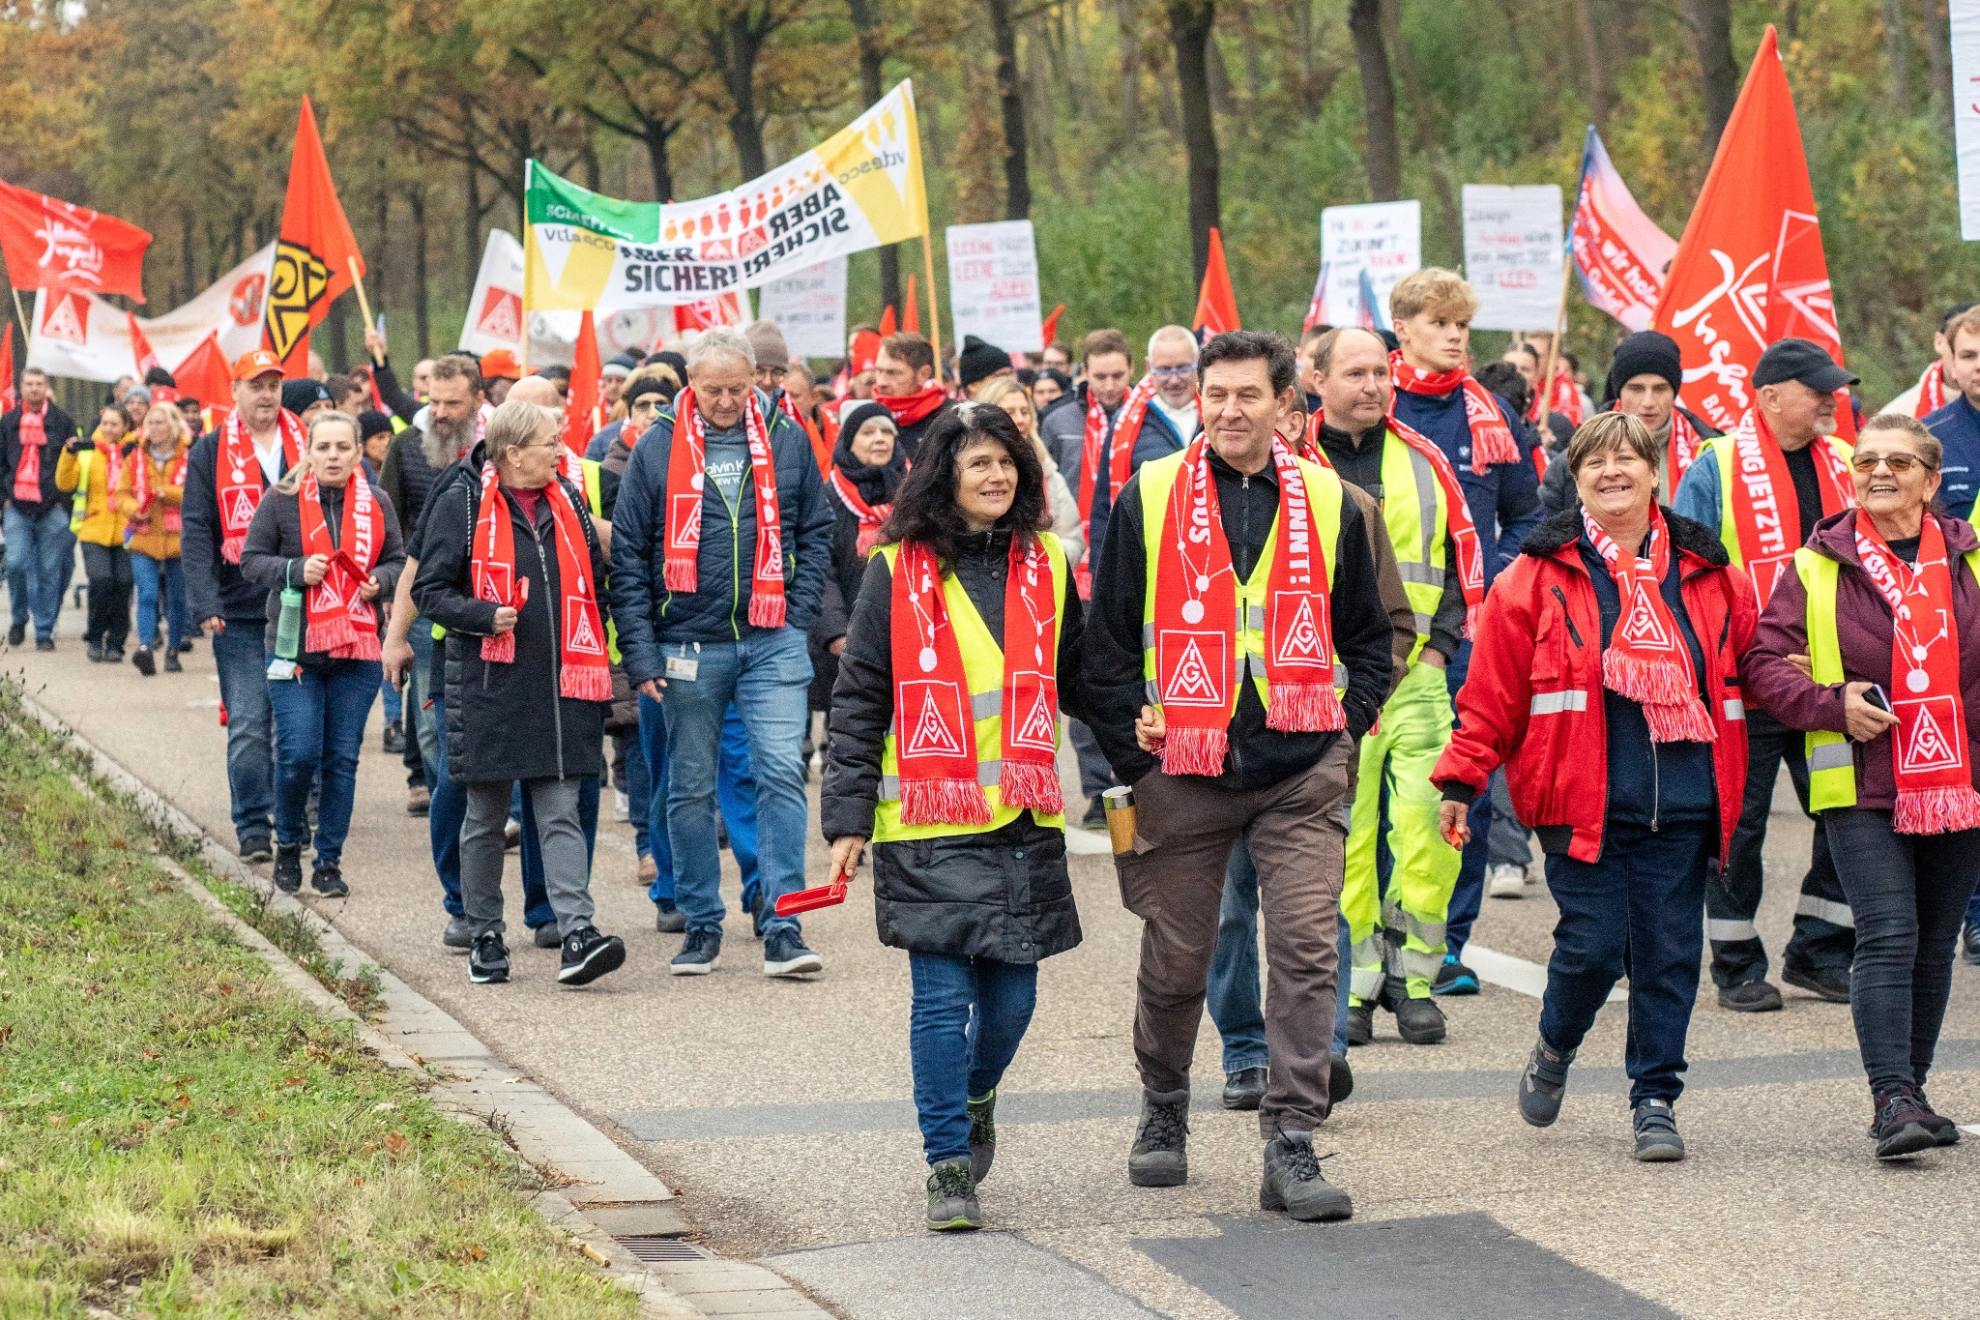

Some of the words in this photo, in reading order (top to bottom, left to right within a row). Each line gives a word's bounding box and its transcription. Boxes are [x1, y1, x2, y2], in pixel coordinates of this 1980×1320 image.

[624, 264, 739, 294] SICHER!
[705, 460, 735, 474] alvin
[1272, 434, 1311, 586] GEWINNT!
[1741, 472, 1787, 556] JETZT!
